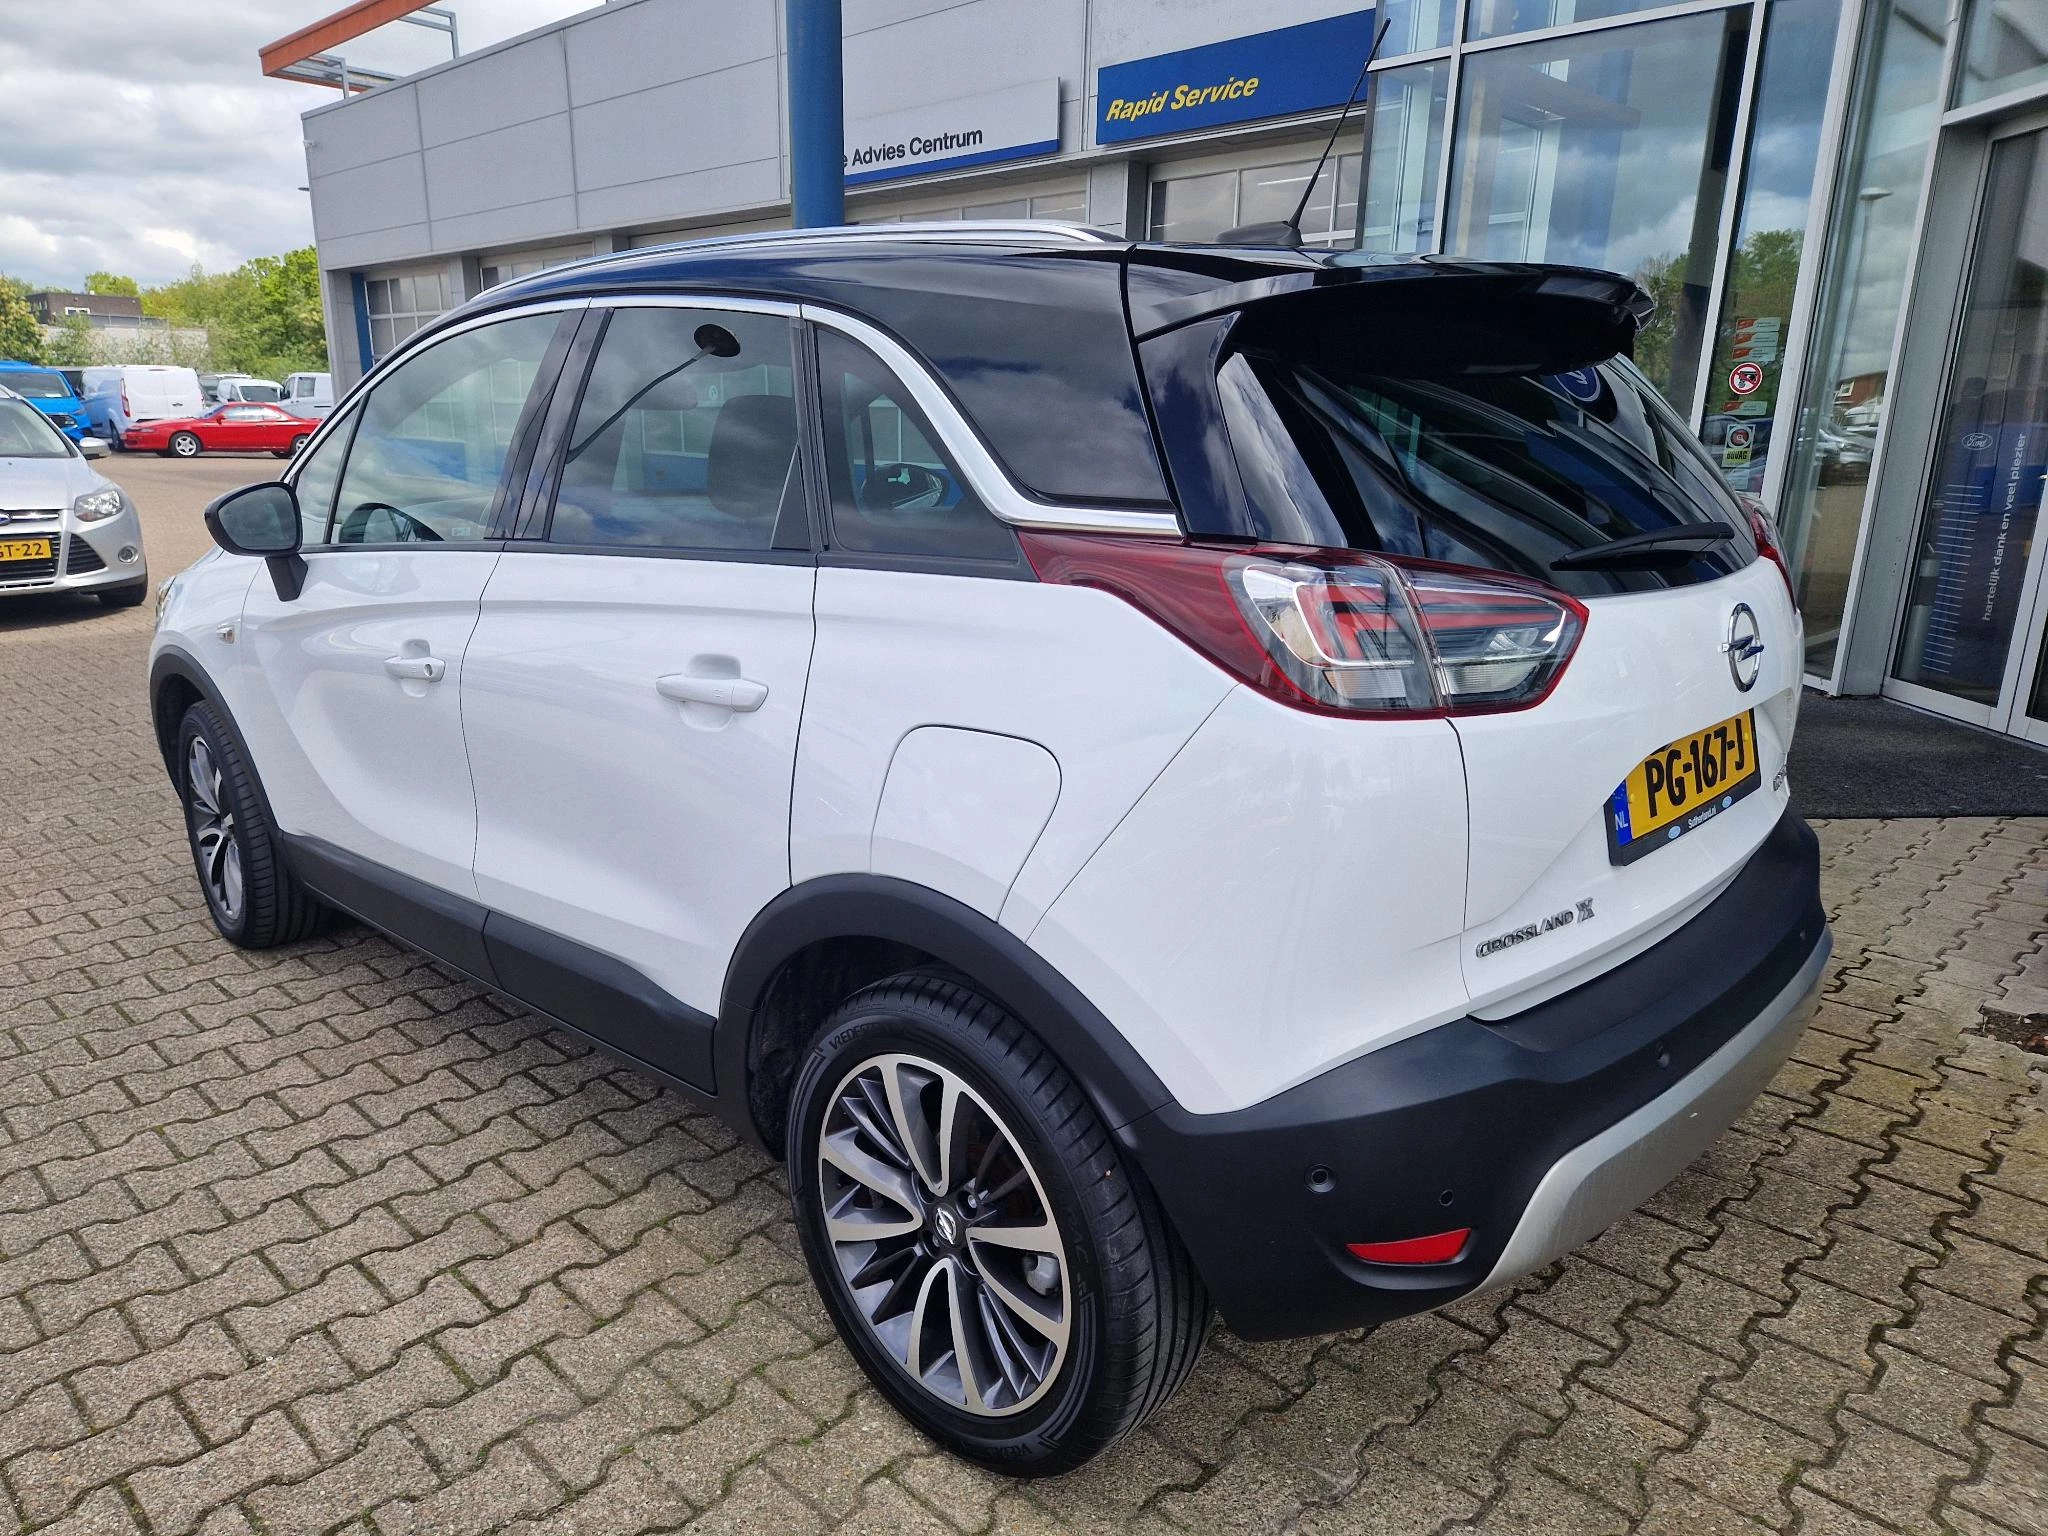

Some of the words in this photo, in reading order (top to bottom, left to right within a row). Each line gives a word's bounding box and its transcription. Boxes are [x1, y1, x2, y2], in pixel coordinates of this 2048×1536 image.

[1106, 90, 1169, 121] Rapid
[1171, 77, 1259, 110] Service
[852, 144, 906, 166] Advies
[910, 129, 983, 155] Centrum
[1966, 434, 1989, 449] Ford
[2011, 433, 2027, 480] plezier
[2003, 482, 2017, 511] veel
[2001, 513, 2011, 530] en
[1994, 533, 2007, 565] dank
[1982, 566, 2000, 621] hartelijk
[1645, 718, 1745, 818] PG-167-J
[1615, 812, 1629, 831] NL
[1476, 909, 1574, 958] CROSSLAND
[1576, 897, 1595, 923] X
